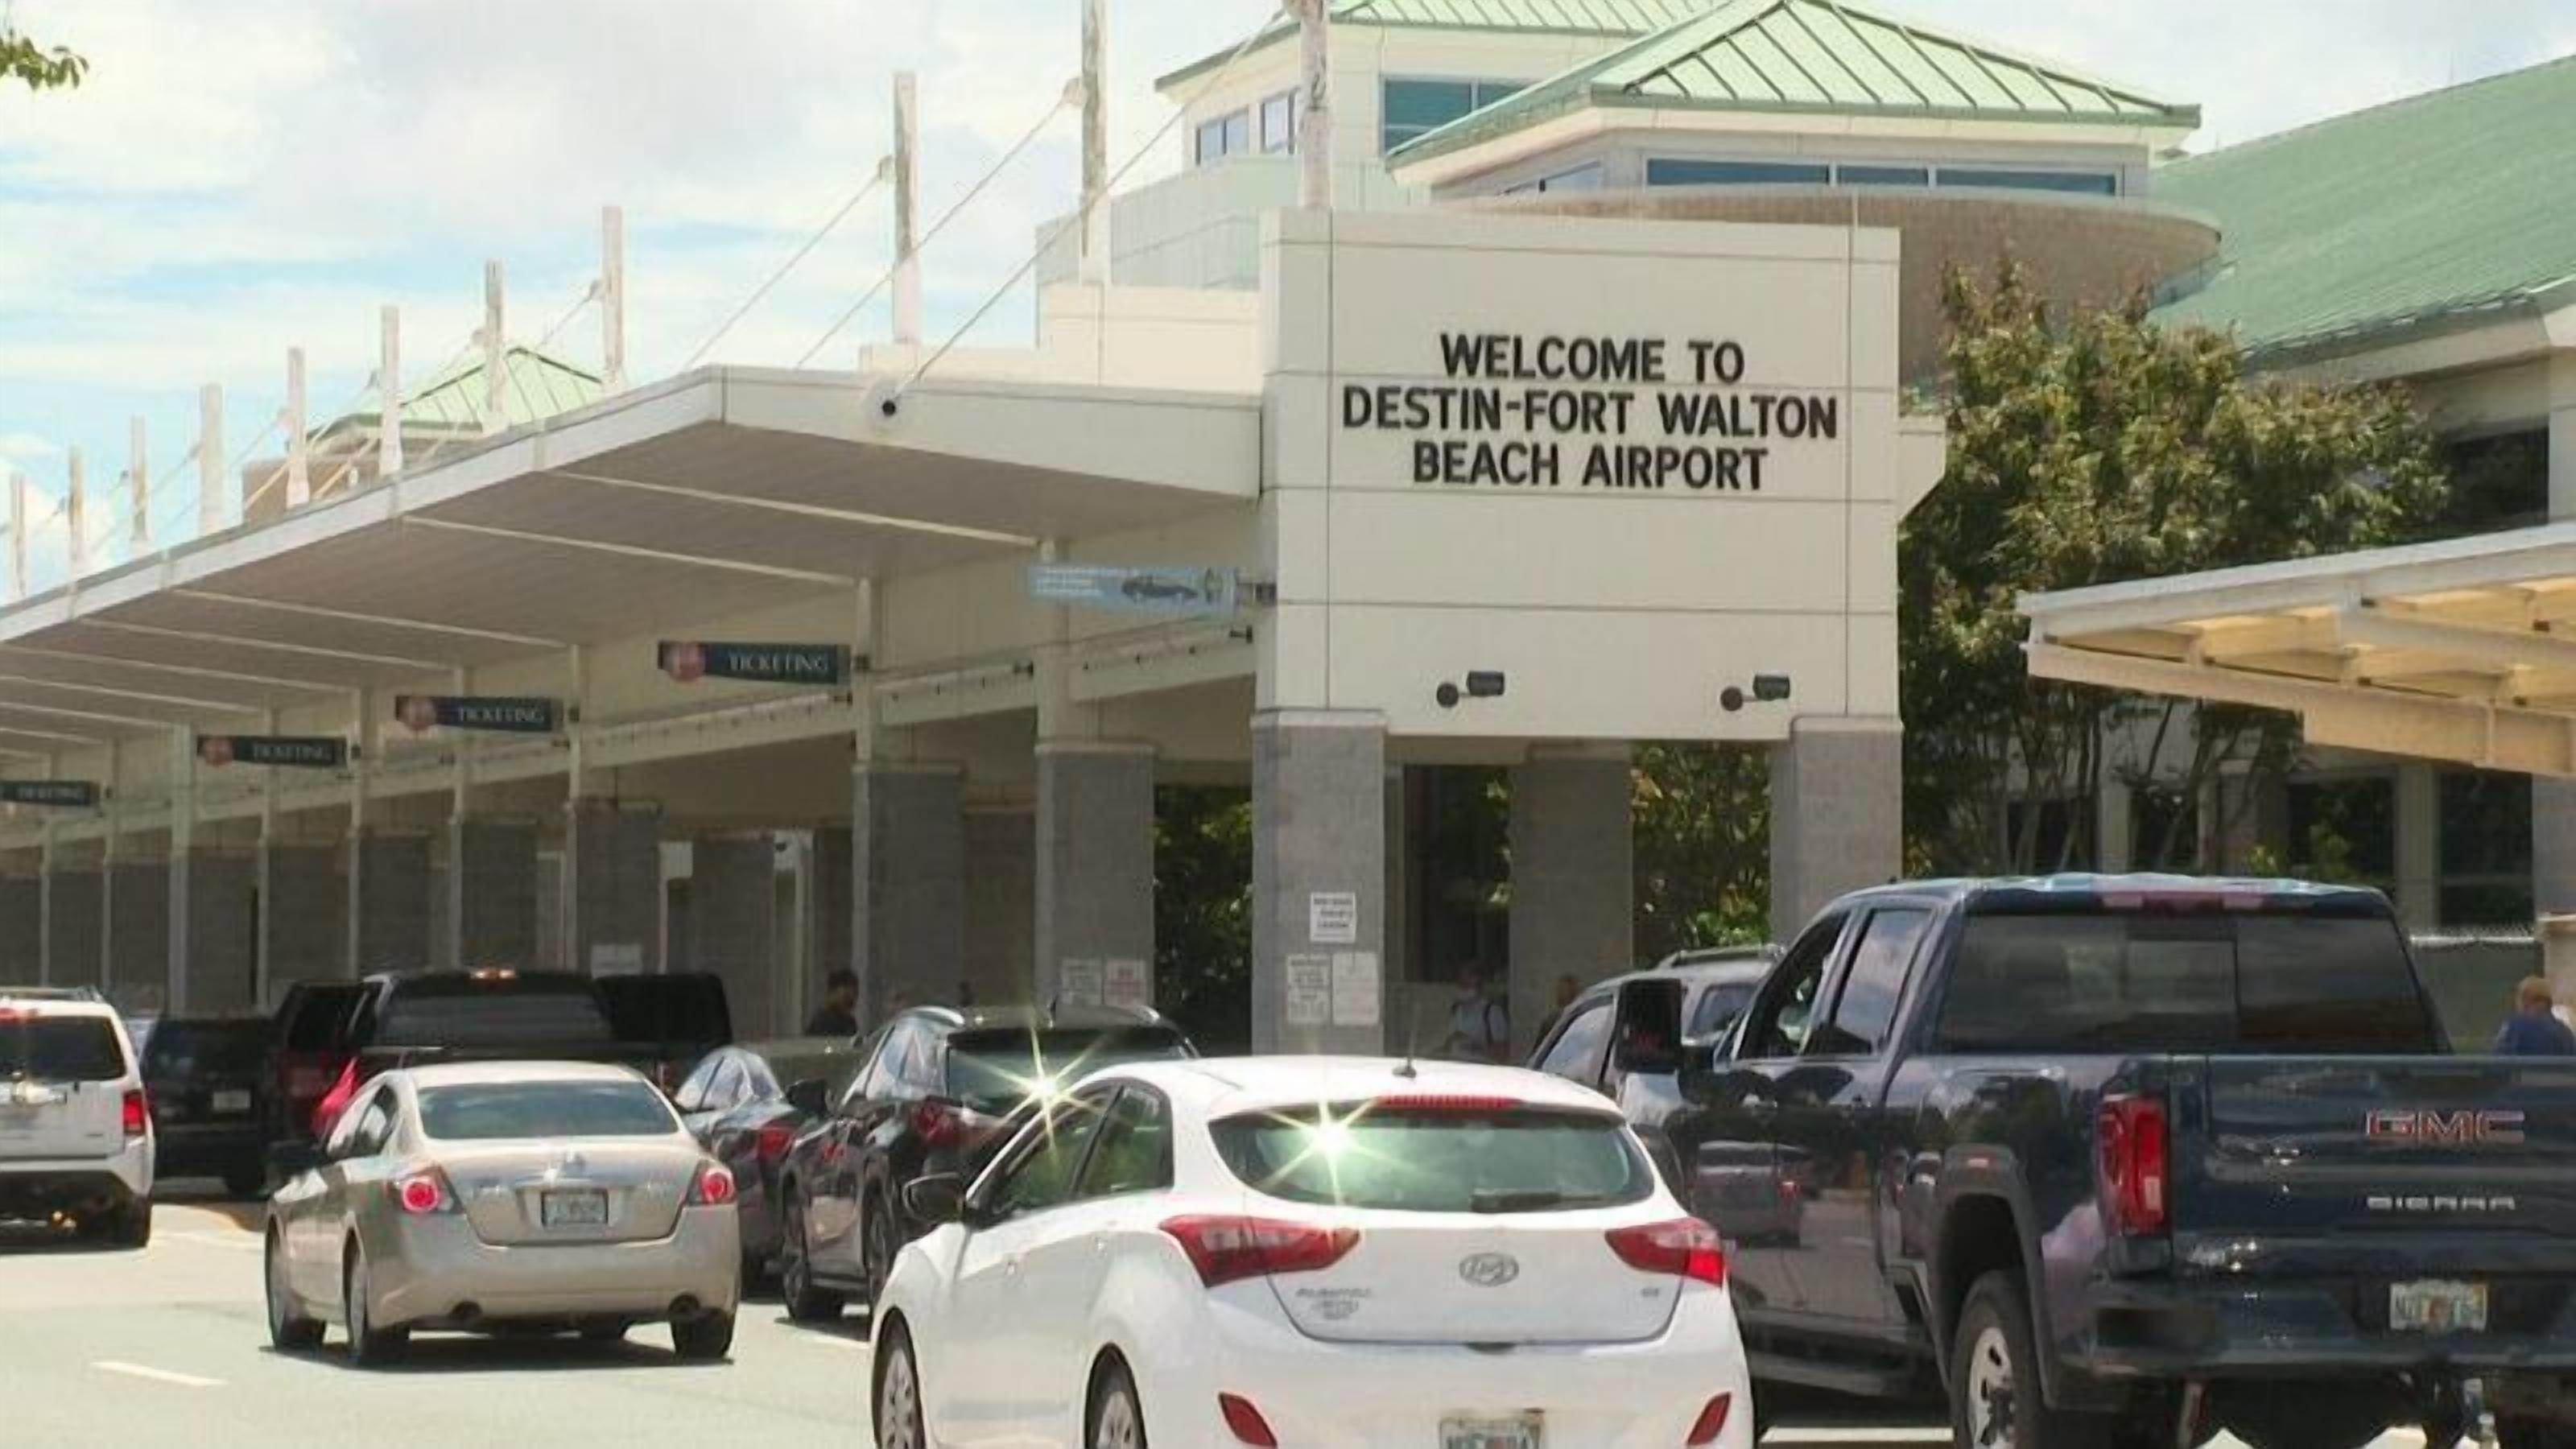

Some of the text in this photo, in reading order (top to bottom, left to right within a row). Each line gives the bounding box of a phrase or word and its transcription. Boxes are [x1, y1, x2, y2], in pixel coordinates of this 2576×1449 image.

[1440, 333, 1745, 386] WELCOME TO
[1342, 386, 1838, 440] DESTIN-FORT WALTON
[1413, 440, 1769, 490] BEACH AIRPORT
[727, 650, 829, 673] TICKETING
[2364, 1109, 2525, 1144] GMC
[2366, 1195, 2516, 1211] SIERRA
